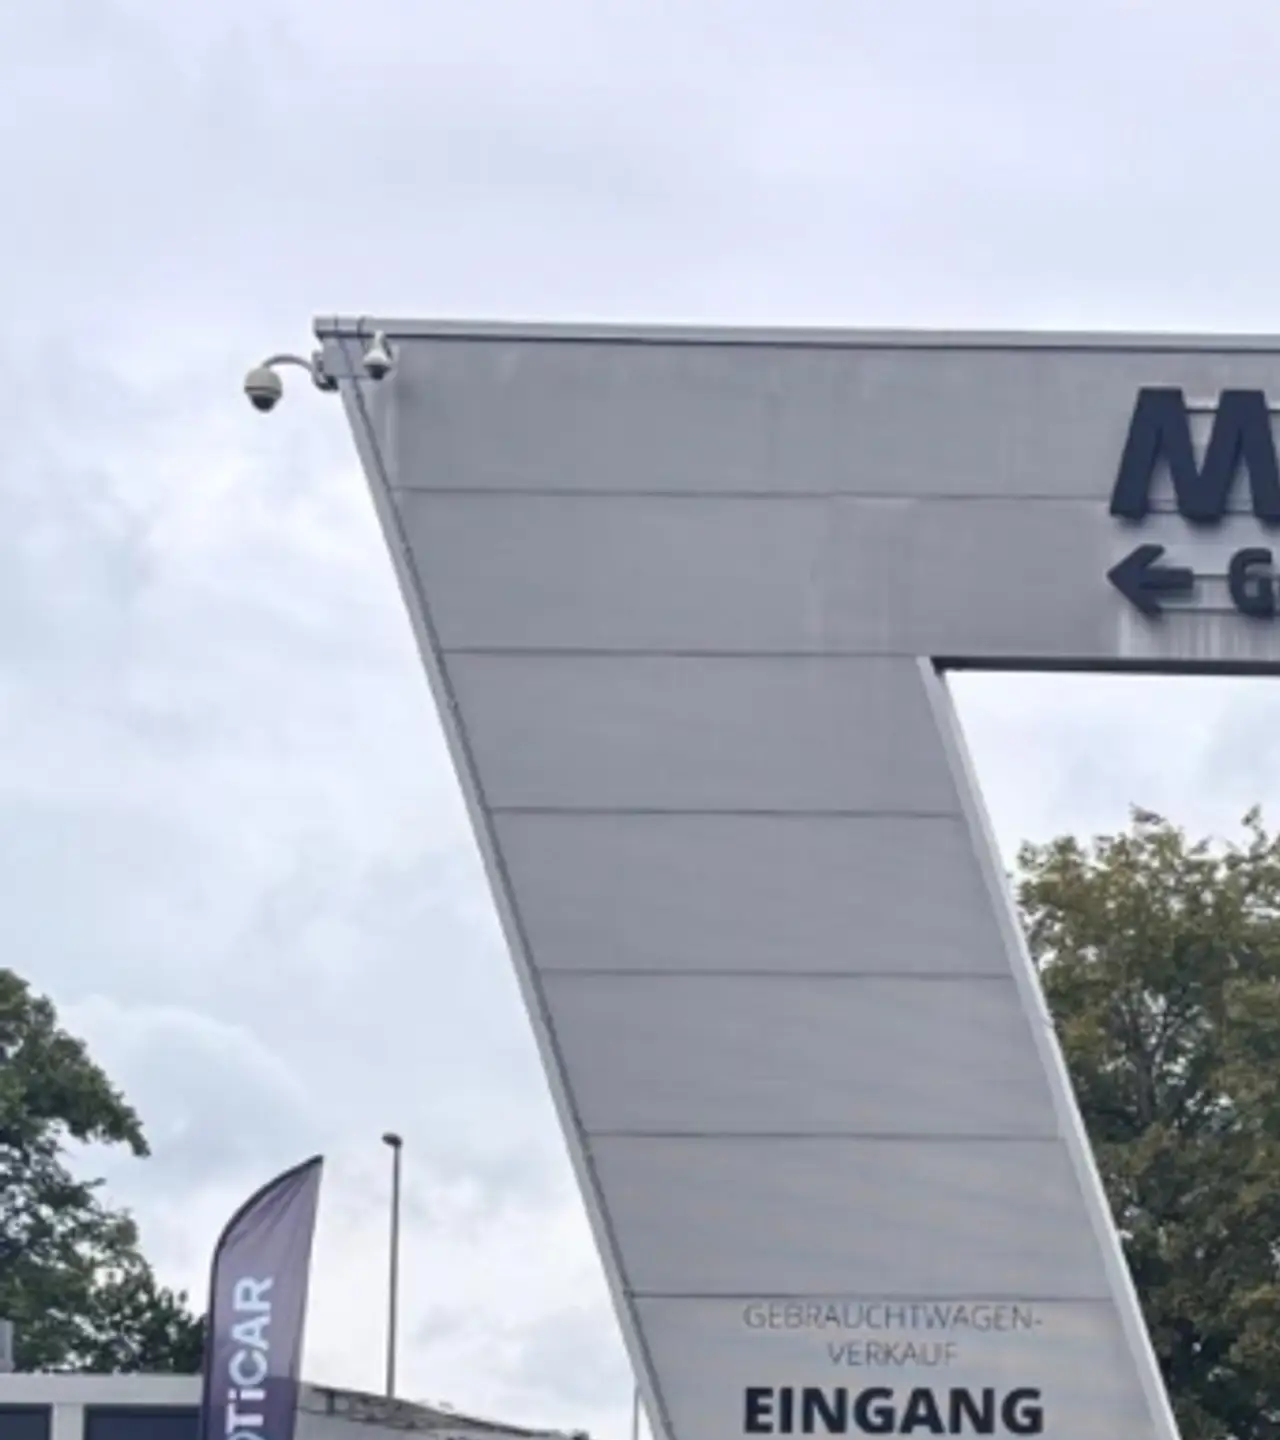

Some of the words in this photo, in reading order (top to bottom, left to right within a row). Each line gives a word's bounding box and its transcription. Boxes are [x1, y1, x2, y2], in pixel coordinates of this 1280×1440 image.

[742, 1304, 1042, 1332] GEBRAUCHTWAGEN-
[828, 1342, 960, 1367] VERKAUF
[743, 1387, 1045, 1434] EINGANG
